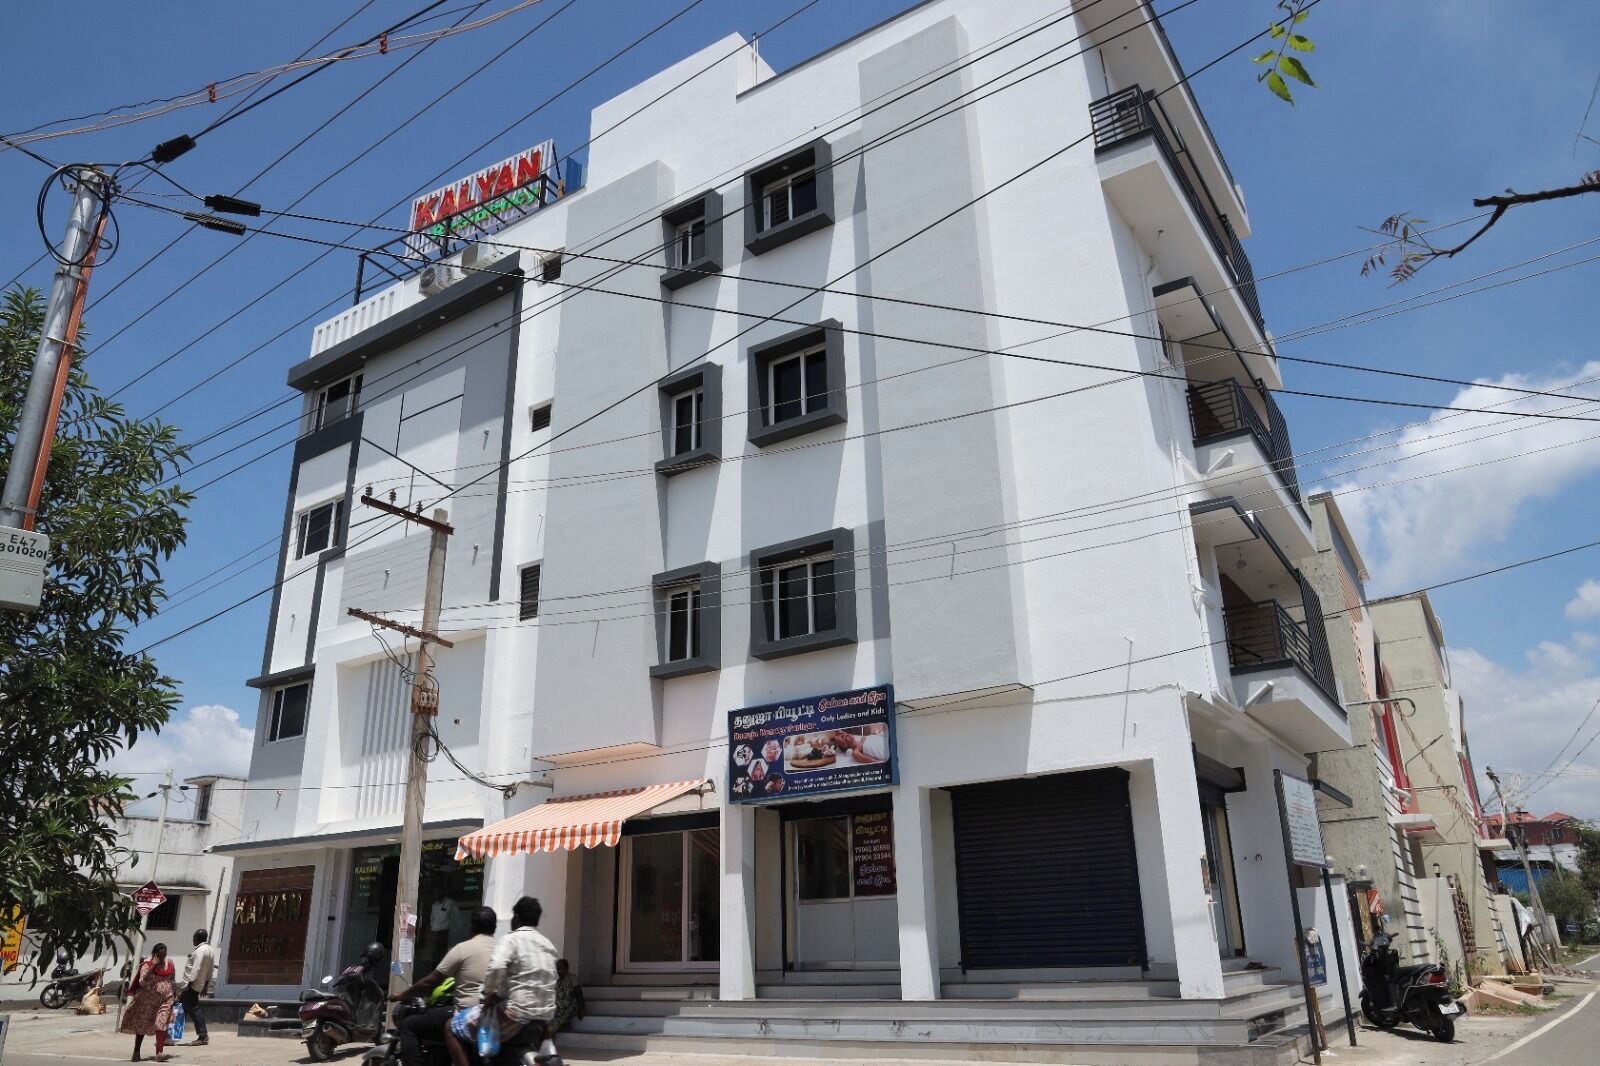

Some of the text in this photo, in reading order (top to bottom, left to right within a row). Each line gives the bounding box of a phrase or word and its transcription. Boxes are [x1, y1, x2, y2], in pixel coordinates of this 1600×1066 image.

[414, 149, 542, 231] KALYAN
[10, 534, 37, 547] E47
[817, 690, 886, 713] Saloon and Spa
[733, 704, 815, 729] தனுஜா பியூட்டி
[820, 706, 885, 724] Only Ladies and Kids
